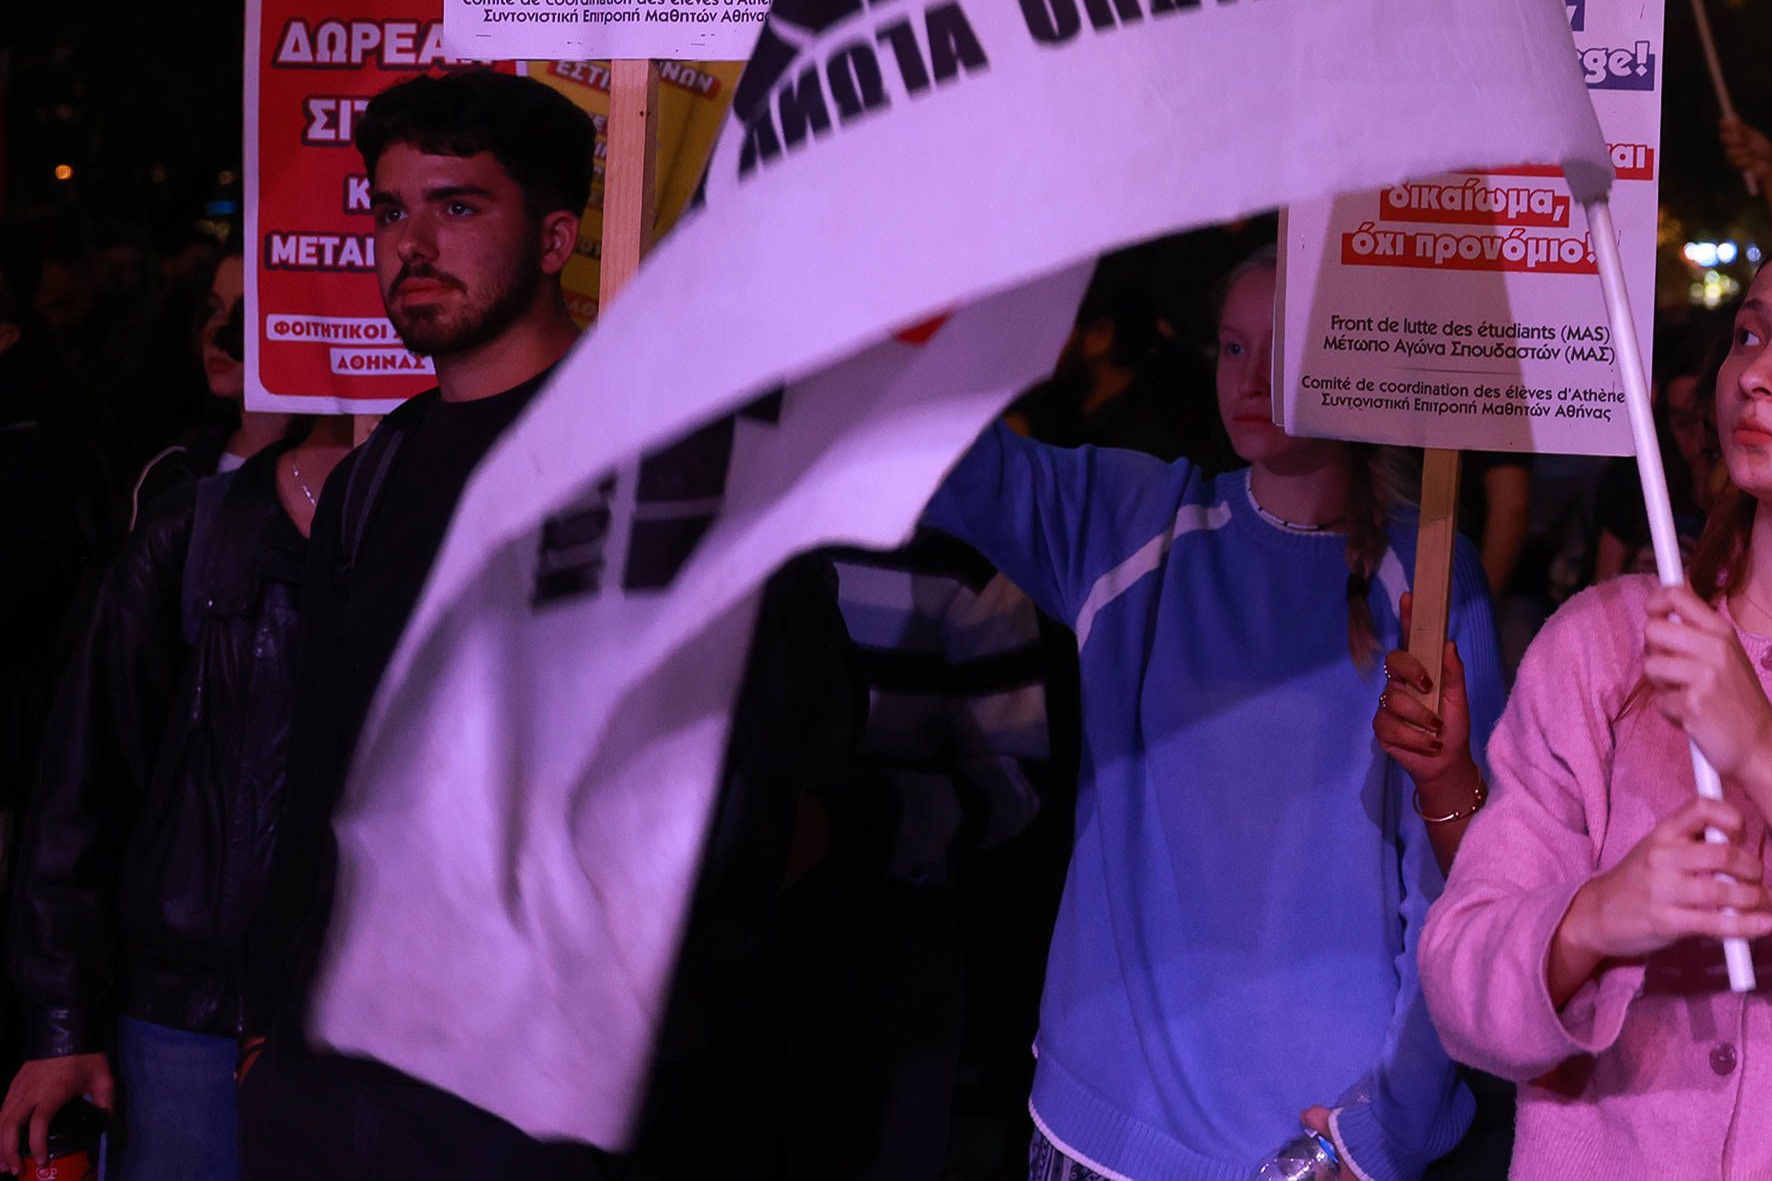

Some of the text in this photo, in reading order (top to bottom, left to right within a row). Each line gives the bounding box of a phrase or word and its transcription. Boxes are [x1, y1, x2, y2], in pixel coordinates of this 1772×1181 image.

[483, 9, 579, 24] Συντονιστική
[583, 8, 640, 25] Επιτροπή
[645, 8, 717, 23] Μαθητών
[275, 19, 497, 65] ΔΩΡΕΑ
[1388, 178, 1566, 222] δικαίωμα,
[1351, 222, 1406, 257] όχι
[273, 321, 388, 339] ΦΟΙΤΗΤΙΚΟΙ
[1331, 315, 1610, 345] Front de lutte des étudiants (MAS)
[1323, 334, 1616, 365] Μέτωπο Αγώνα Σπουδαστών (ΜΑΣ)
[1301, 375, 1626, 404] Comité de coordination des élèves d'Athène
[1321, 393, 1612, 423] Συντονιστική Επιτροπή Μαθητών Αθήνας
